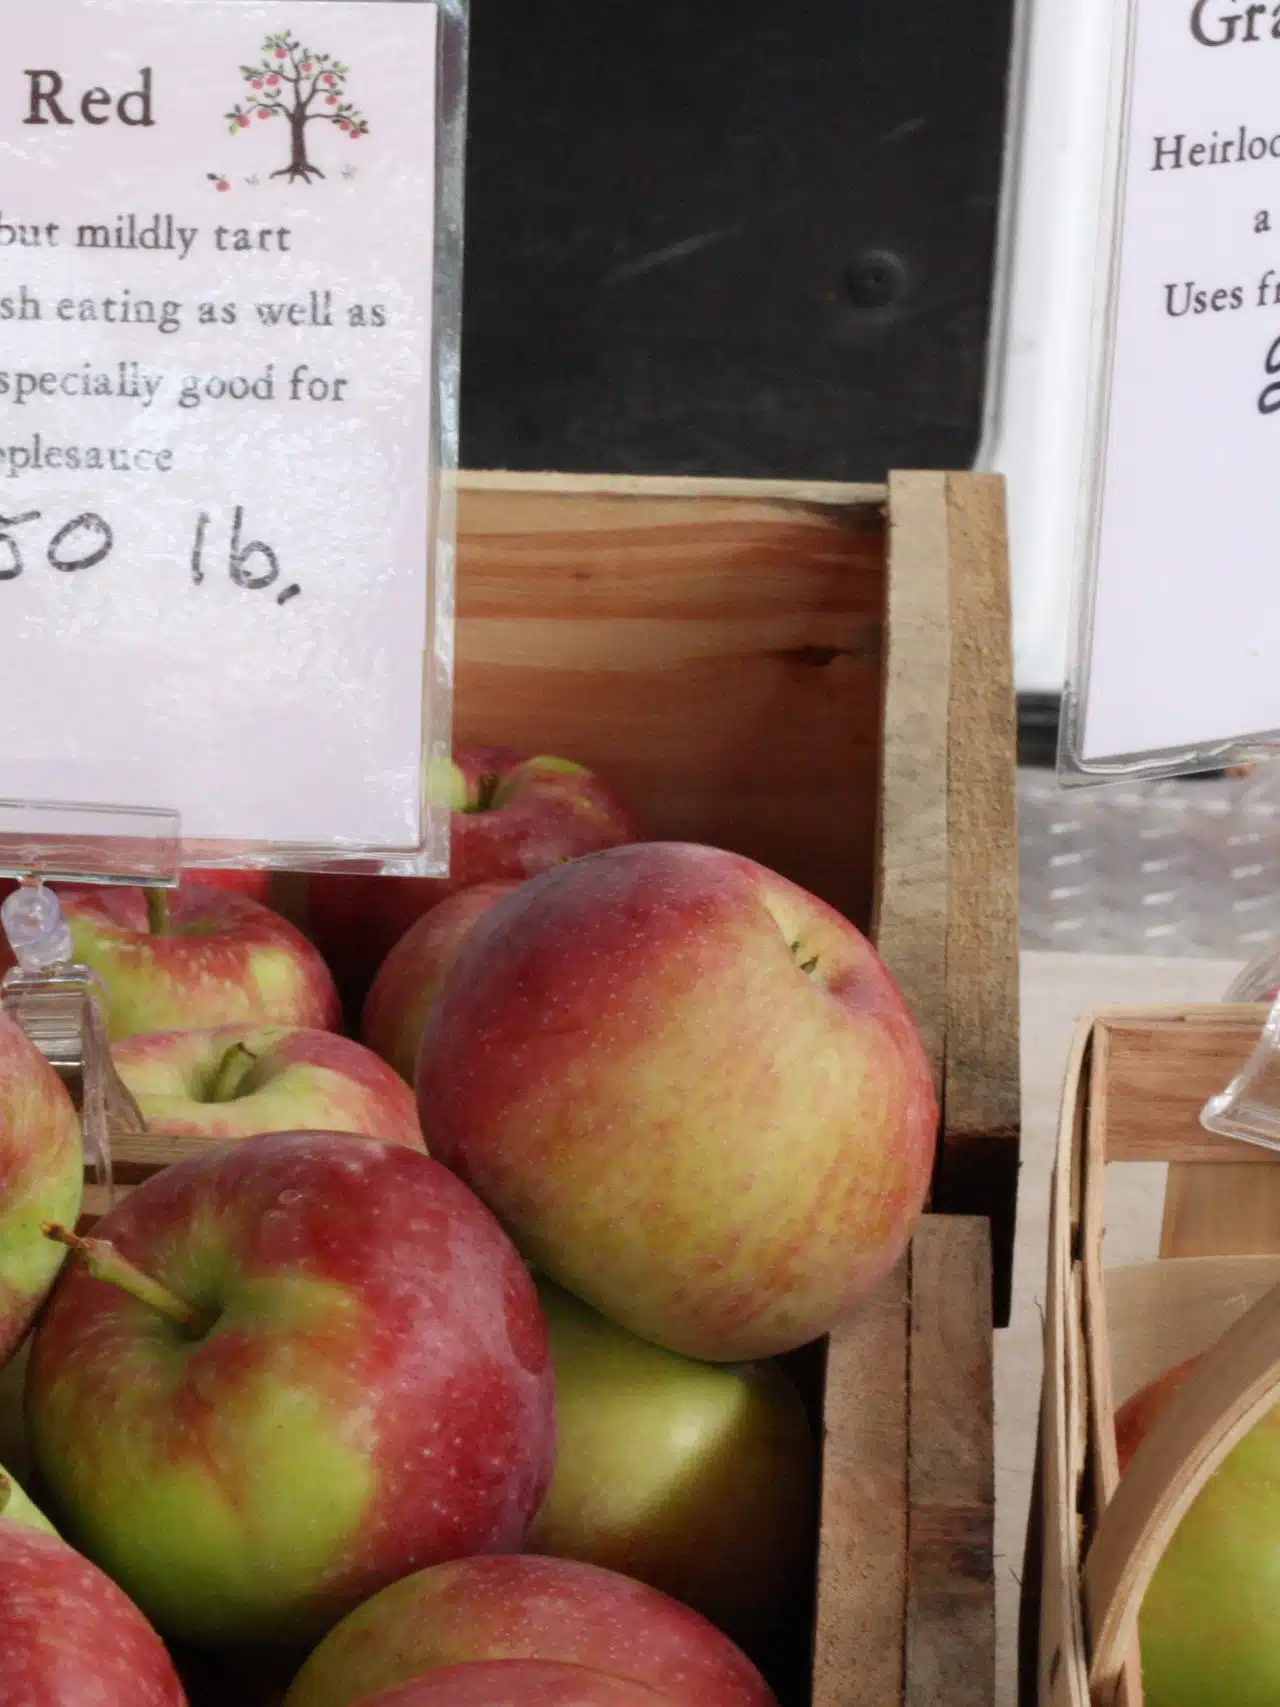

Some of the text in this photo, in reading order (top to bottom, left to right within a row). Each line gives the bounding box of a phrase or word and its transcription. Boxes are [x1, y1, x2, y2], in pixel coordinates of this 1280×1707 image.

[23, 68, 156, 127] Red
[76, 213, 198, 260] mildly
[215, 224, 292, 252] tart
[1254, 209, 1271, 233] a
[56, 289, 183, 334] eating
[198, 301, 237, 324] as
[255, 290, 334, 326] well
[347, 303, 386, 327] as
[1164, 282, 1244, 317] Uses
[178, 364, 276, 408] good
[289, 365, 348, 401] for
